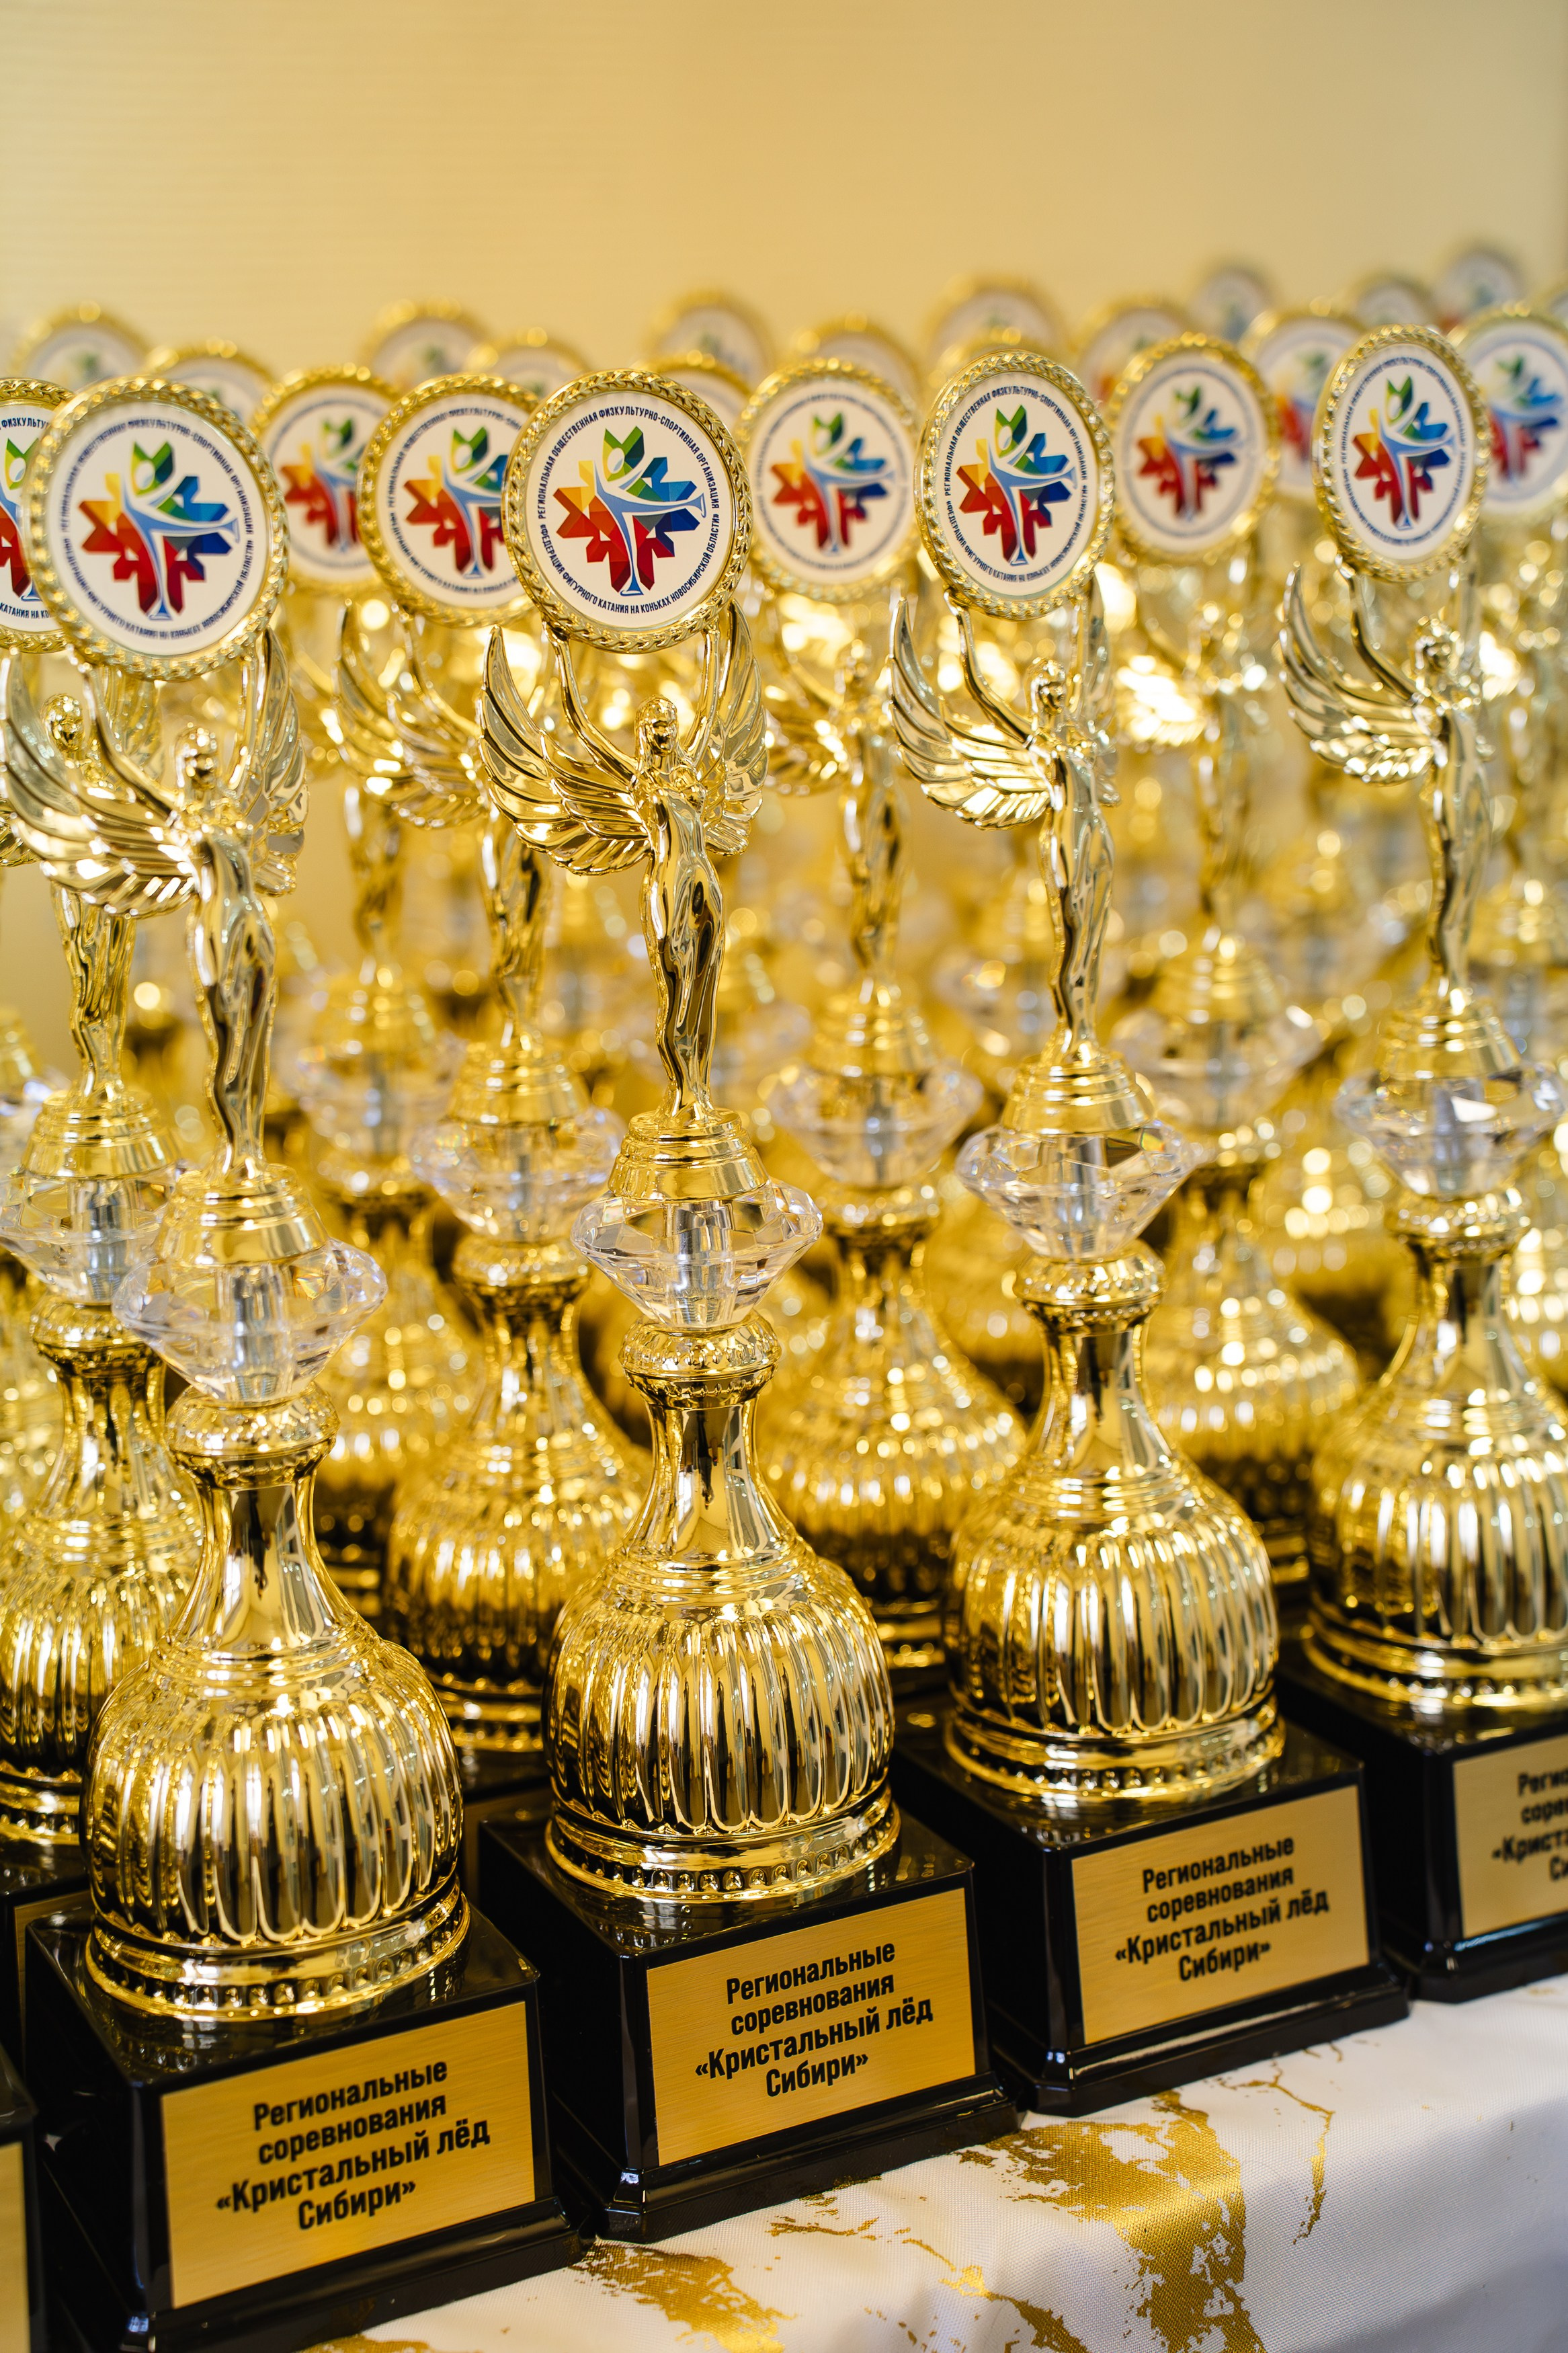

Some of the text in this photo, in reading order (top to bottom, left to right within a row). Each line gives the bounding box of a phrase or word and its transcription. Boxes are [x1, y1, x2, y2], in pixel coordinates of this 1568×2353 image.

[1, 417, 50, 430] ФИЗКУЛЬТУ
[944, 436, 958, 496] РЕГИОНАЛЬНАЯ
[954, 392, 991, 436] ОБЩЕСТВЕННАЯ
[538, 455, 556, 520] РЕГИОНАЛЬНАЯ
[552, 412, 598, 456] ОБЩЕСТВЕННАЯ
[599, 405, 700, 454] ФИЗКУЛЬТУРНО-СПОРТИВНАЯ
[696, 452, 719, 509] ОРГАНИЗАЦИЯ
[540, 524, 565, 574] «ФЕДЕРАЦИЯ
[563, 572, 598, 604] ФИГУРНОГО
[597, 598, 628, 614] КАТАНИЯ
[630, 605, 639, 614] НА
[641, 596, 671, 613] КОНЬКАХ
[671, 552, 712, 602] НОВОСИБИРСКОЙ
[706, 514, 720, 553] ОБЛАСТИ»
[31, 610, 40, 619] НА
[1143, 1837, 1294, 1893] Региональные
[1147, 1867, 1294, 1923] соревнования
[1115, 1889, 1329, 1964] «Кристальный лёд
[727, 1942, 895, 2004] Региональные
[1179, 1941, 1271, 1981] Сибири»
[731, 1975, 894, 2035] соревнования
[695, 1997, 934, 2079] «Кристальный лёд
[253, 2061, 448, 2130] Региональные
[766, 2052, 868, 2097] Сибири»
[258, 2095, 446, 2165] соревнования
[216, 2118, 491, 2212] «Кристальный лёд
[298, 2180, 415, 2230] Сибири»
